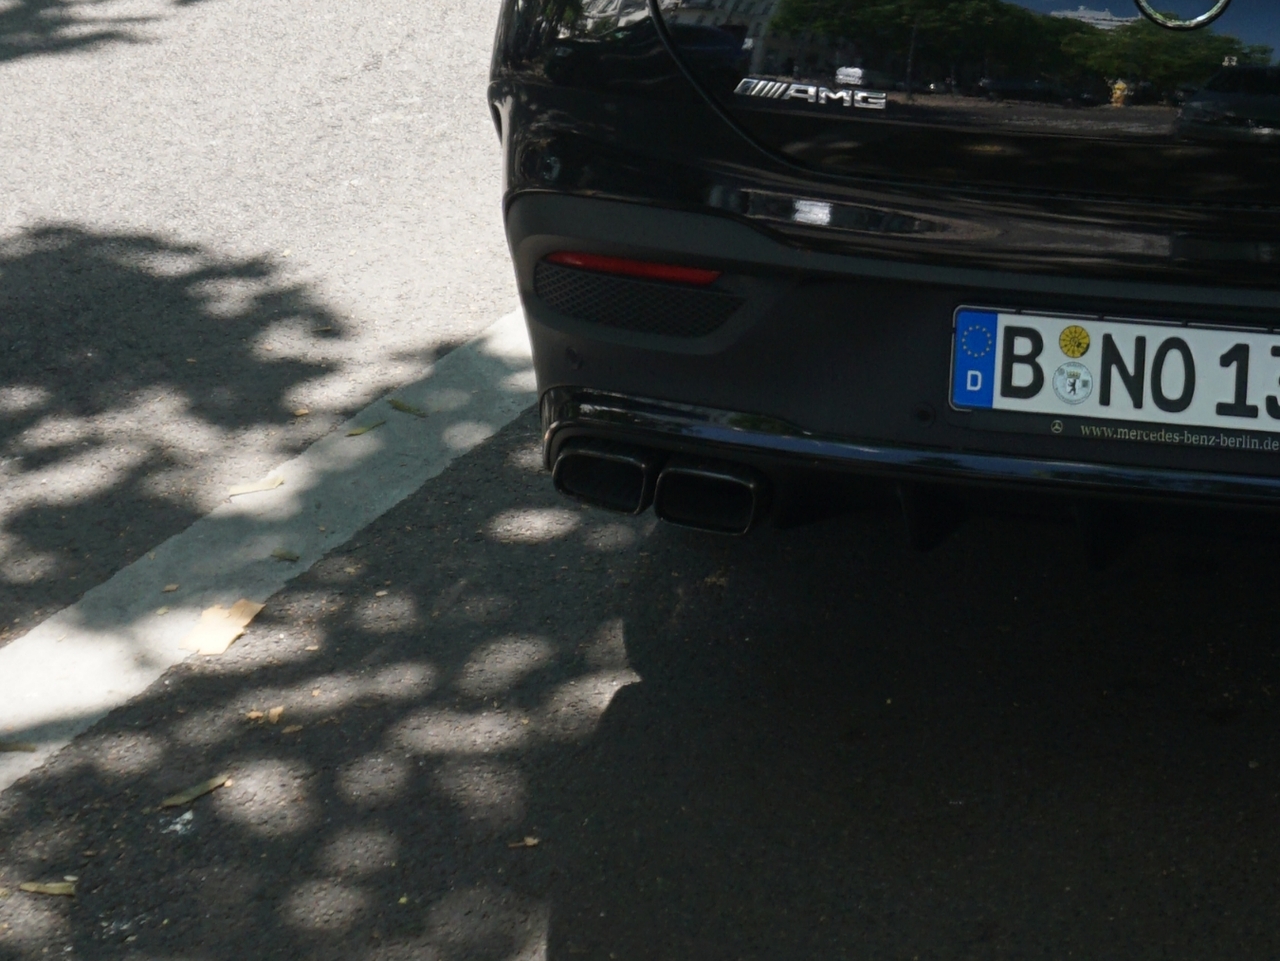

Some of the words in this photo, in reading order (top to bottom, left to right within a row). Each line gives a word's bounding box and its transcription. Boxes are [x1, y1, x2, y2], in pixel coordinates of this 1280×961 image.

[966, 370, 983, 392] D
[1000, 325, 1045, 400] B
[1099, 333, 1196, 414] NO
[1080, 423, 1280, 452] www.mercedes-benz-berlin.de
